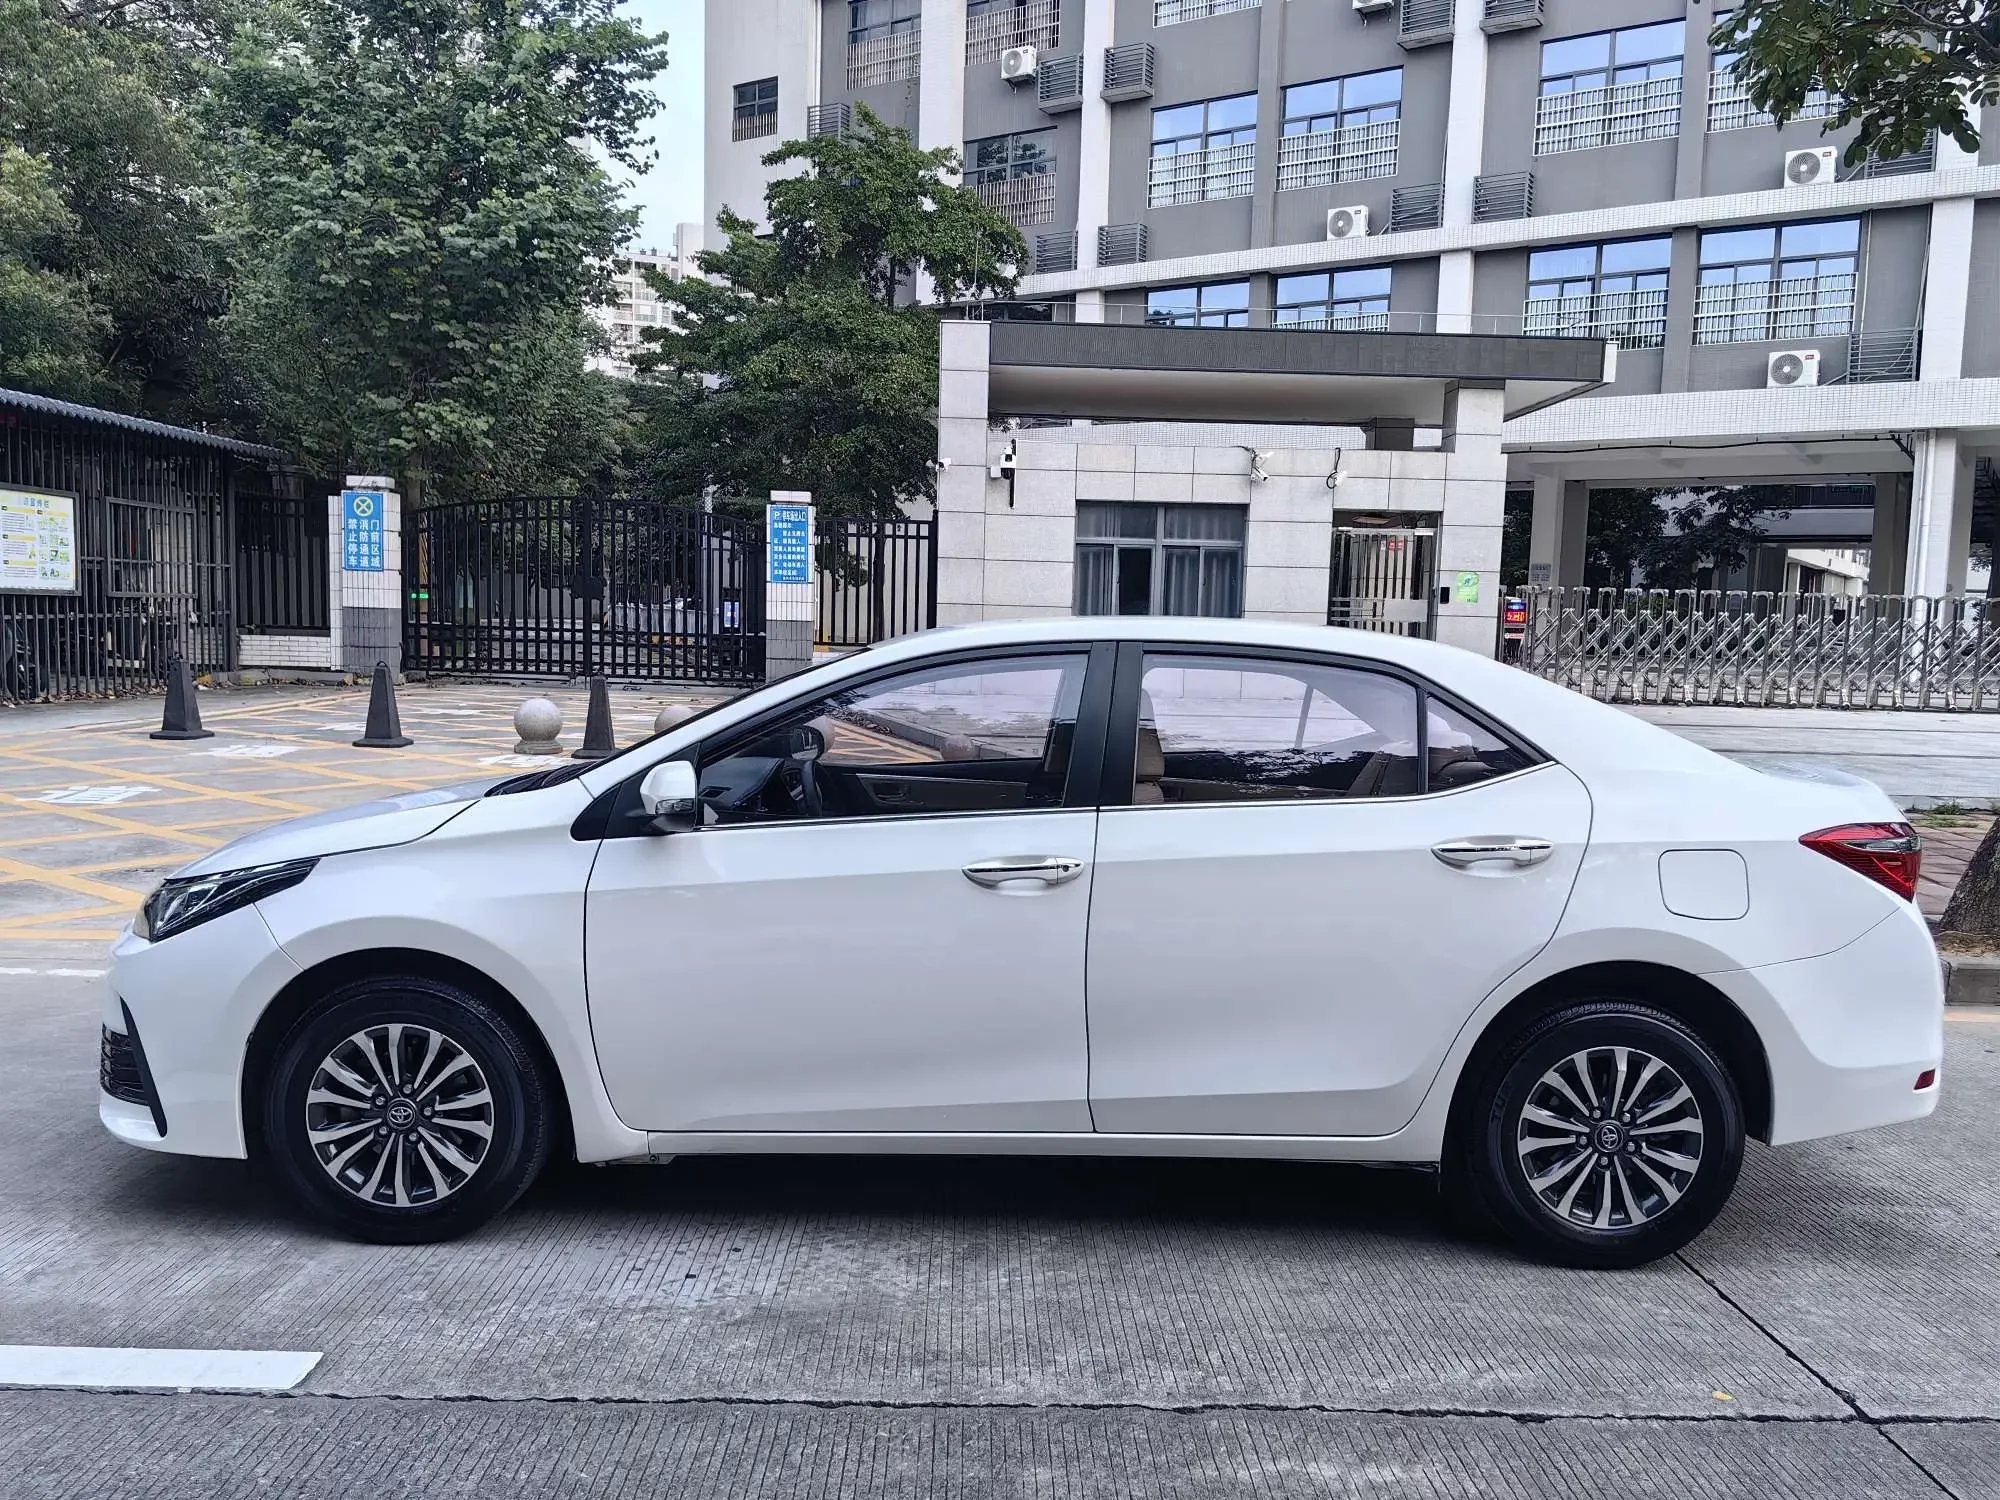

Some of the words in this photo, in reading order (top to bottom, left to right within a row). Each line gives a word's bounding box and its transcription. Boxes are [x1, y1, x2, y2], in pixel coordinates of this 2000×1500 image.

[347, 519, 358, 567] 禁止停车
[359, 519, 370, 567] 消防通道
[370, 519, 381, 567] 门前区域
